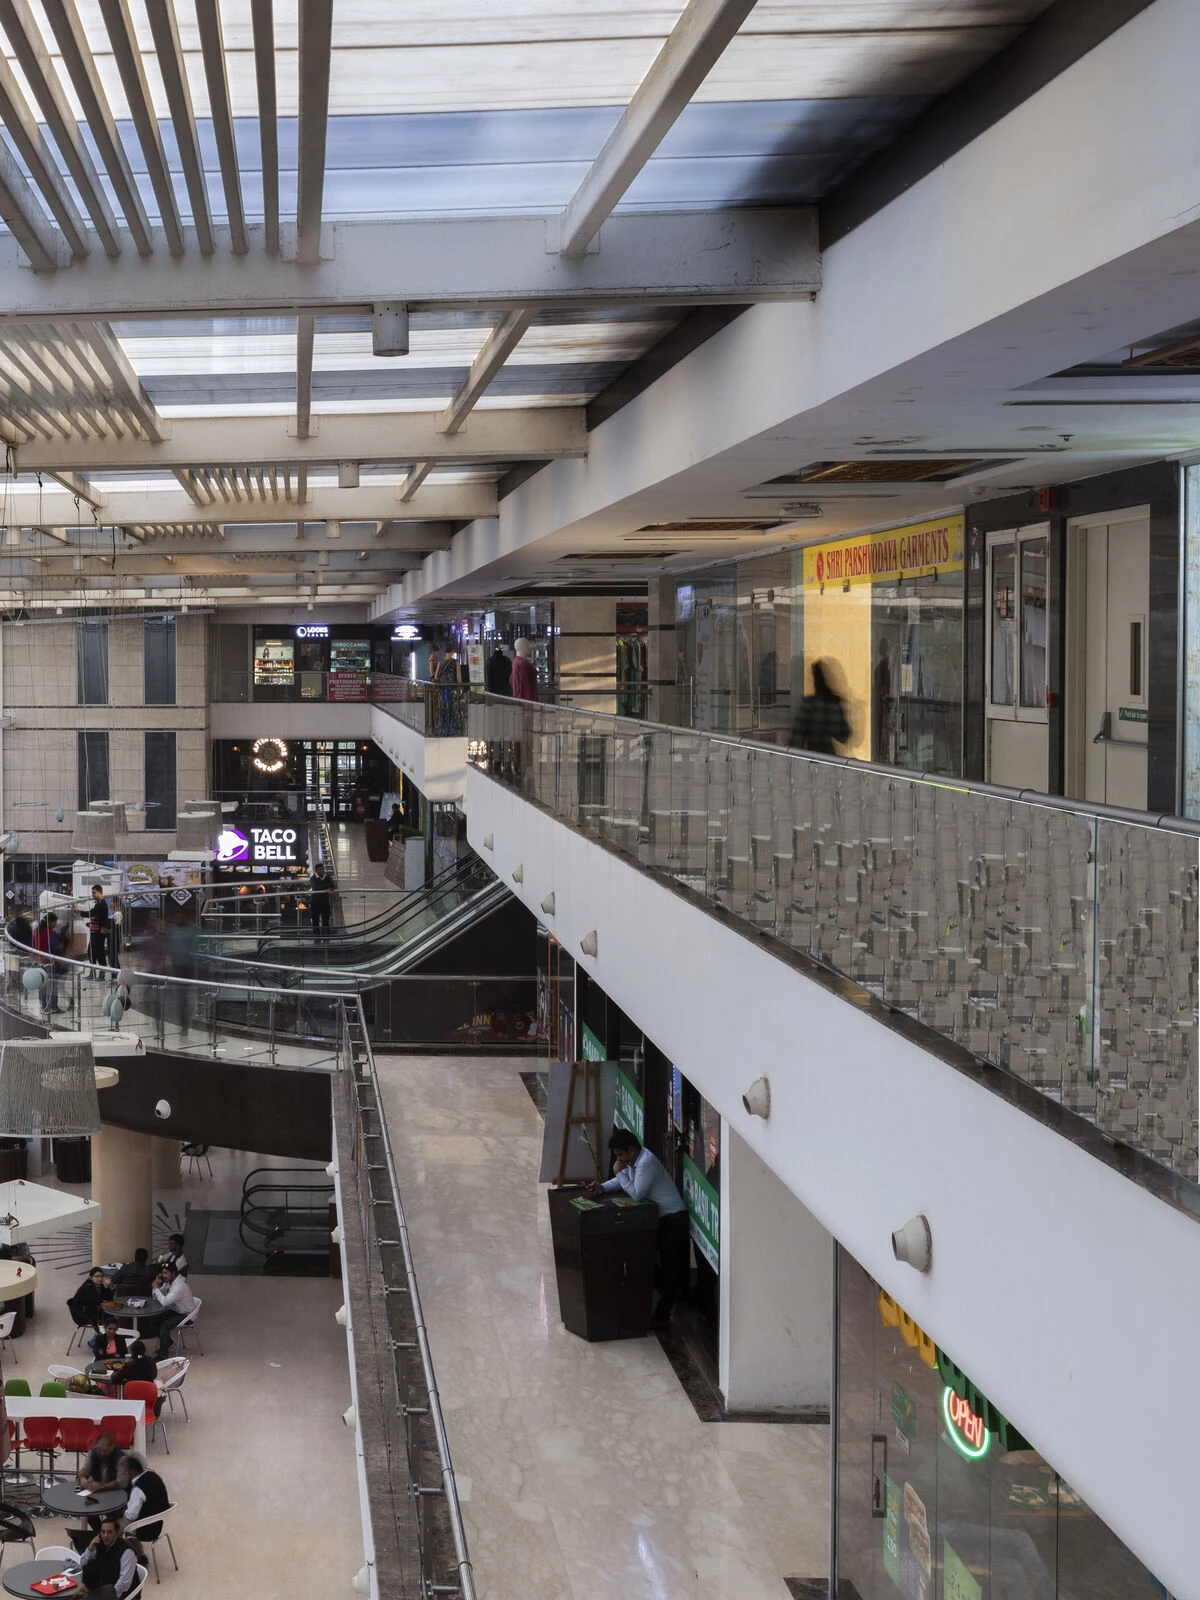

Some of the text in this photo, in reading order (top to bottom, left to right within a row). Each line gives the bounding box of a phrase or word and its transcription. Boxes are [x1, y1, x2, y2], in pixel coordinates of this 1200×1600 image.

[826, 549, 843, 579] SHRI
[900, 528, 949, 569] GARMENTS
[250, 828, 297, 843] TACO
[254, 845, 297, 860] BELL
[621, 1084, 635, 1128] BASIL
[694, 1179, 711, 1231] BASIL
[950, 1389, 983, 1448] OPEN
